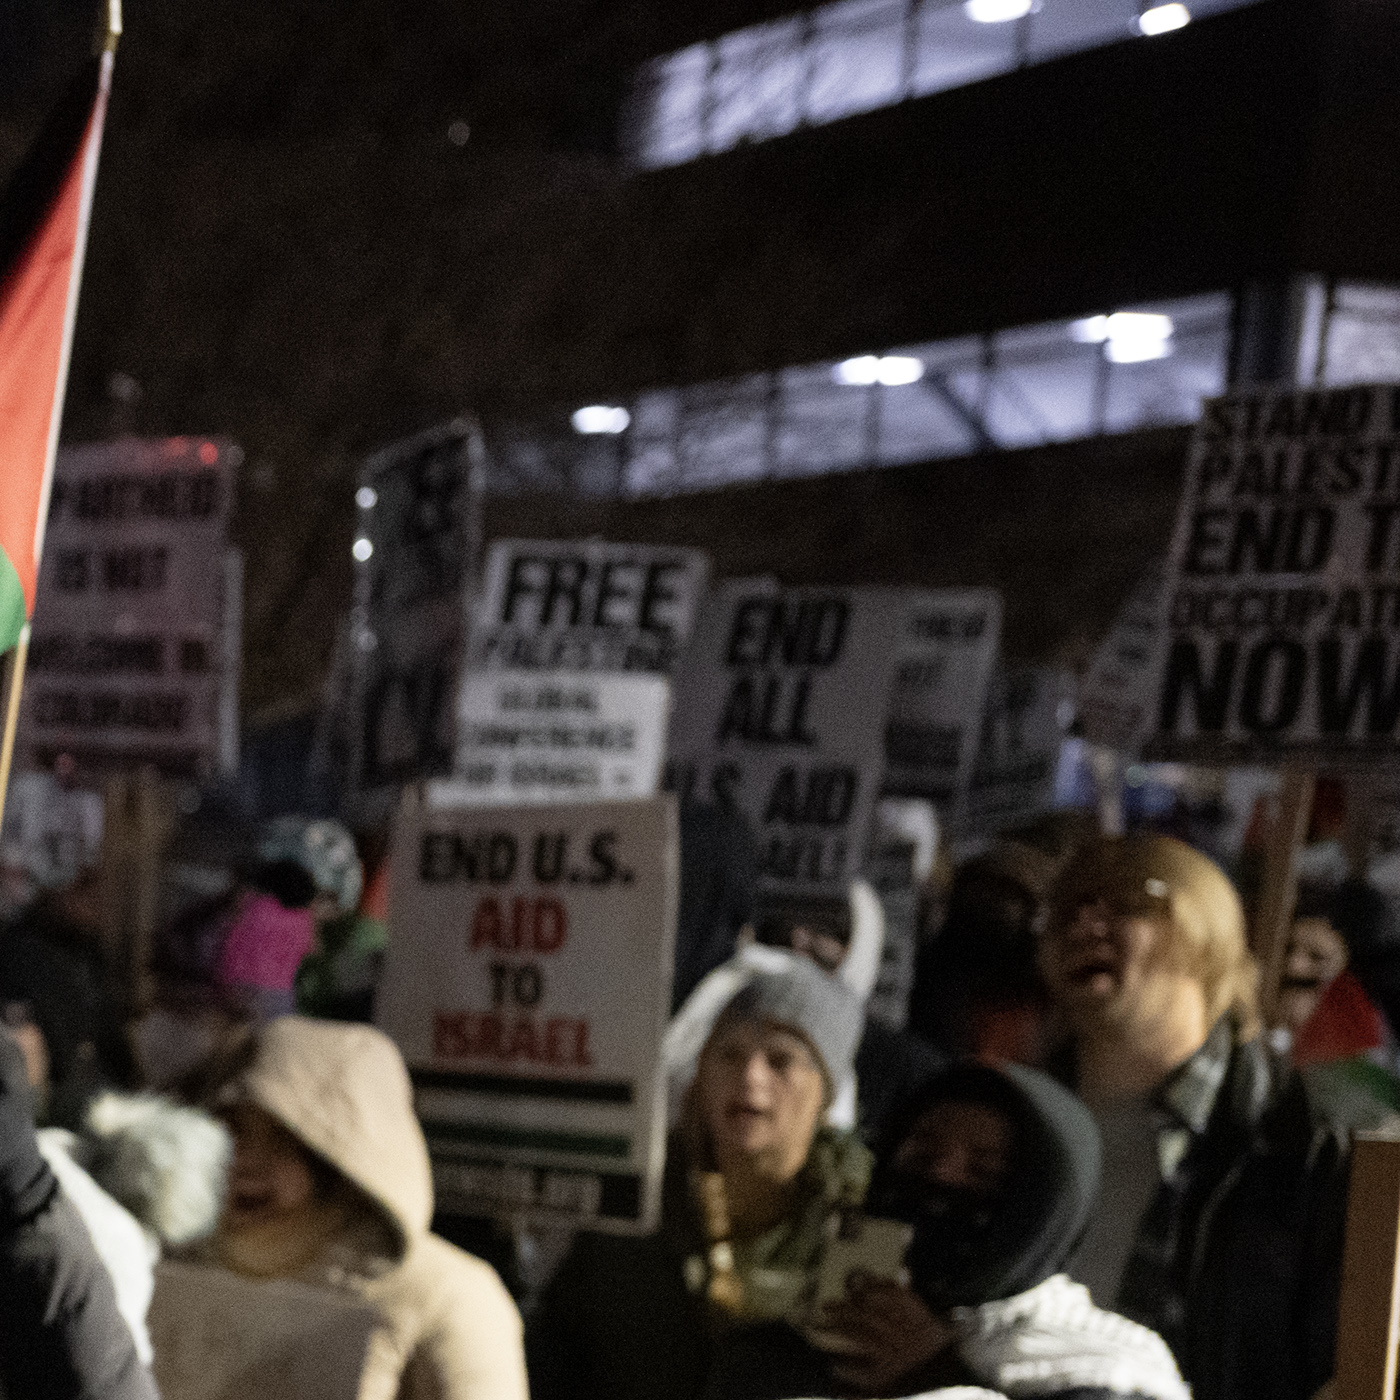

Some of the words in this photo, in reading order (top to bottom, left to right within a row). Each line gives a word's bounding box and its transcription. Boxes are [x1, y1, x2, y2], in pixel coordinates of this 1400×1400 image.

[1183, 504, 1337, 574] END
[502, 556, 687, 631] FREE
[725, 597, 849, 668] END
[716, 677, 816, 747] ALL
[1159, 638, 1400, 732] NOW
[762, 763, 857, 827] AID
[419, 829, 518, 886] END
[531, 828, 637, 886] U.S.
[469, 894, 568, 954] AID
[488, 960, 544, 1009] TO
[433, 1006, 593, 1068] ISRAEL
